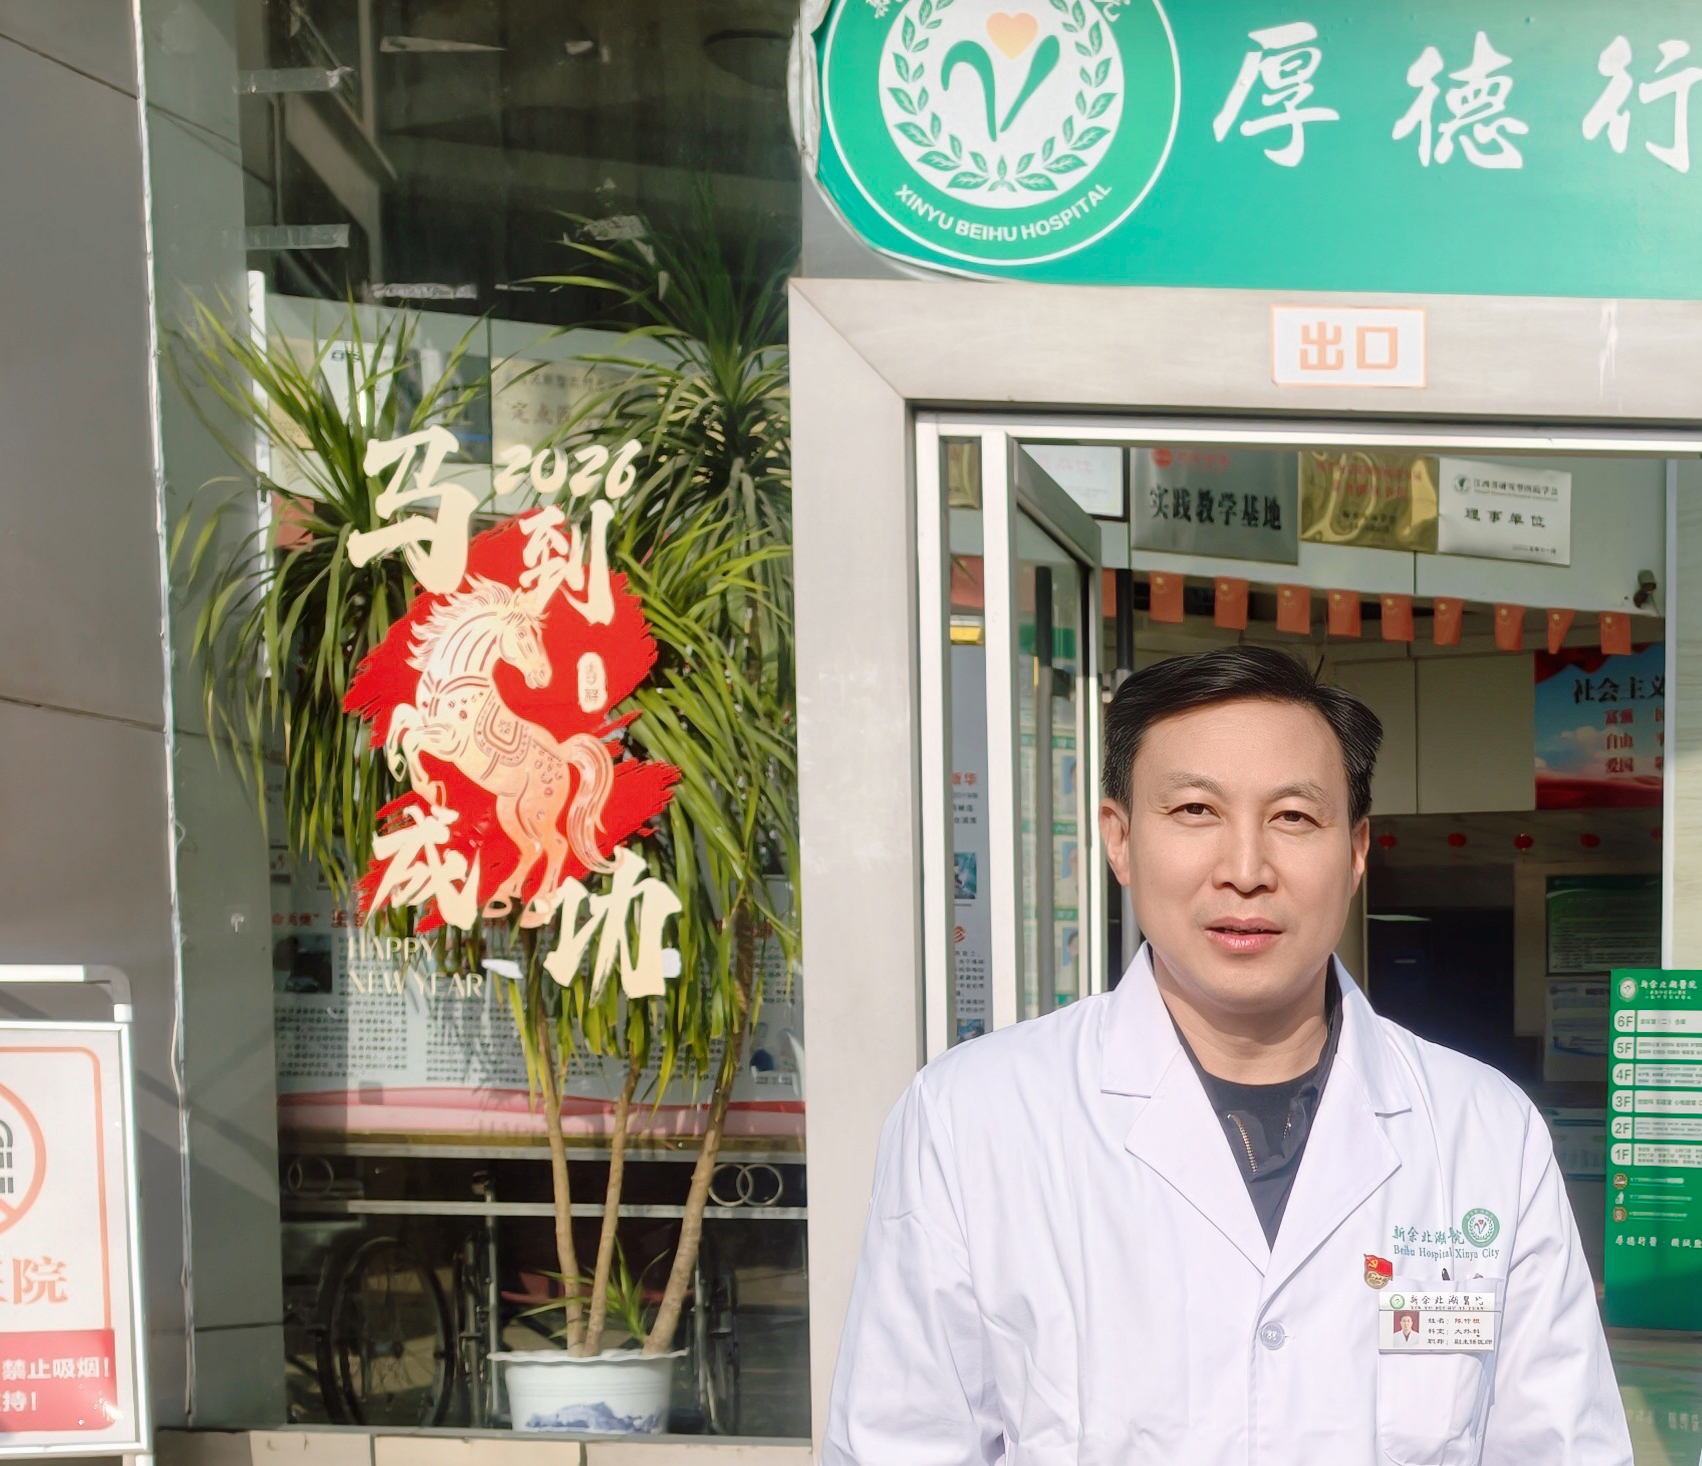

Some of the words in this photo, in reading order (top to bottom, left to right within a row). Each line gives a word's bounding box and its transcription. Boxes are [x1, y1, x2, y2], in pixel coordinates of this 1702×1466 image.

[894, 184, 955, 230] XINYU
[955, 220, 1018, 242] BEIHU
[1020, 184, 1113, 240] HOSPITAL
[1298, 320, 1400, 372] 出口
[494, 439, 642, 499] 2026
[1149, 484, 1282, 531] 实践教学基地
[1464, 506, 1546, 529] 理事单位
[348, 936, 438, 962] HAPPY
[1617, 1015, 1634, 1027] 6F
[1616, 1042, 1633, 1054] 5F
[1616, 1069, 1632, 1080] 4F
[1615, 1095, 1631, 1107] 3F
[1615, 1122, 1631, 1134] 2F
[1615, 1148, 1630, 1160] 1F
[1393, 1245, 1416, 1257] Beihu
[1419, 1247, 1453, 1262] Hospital
[1455, 1248, 1479, 1262] Xinyu
[1482, 1248, 1500, 1259] City
